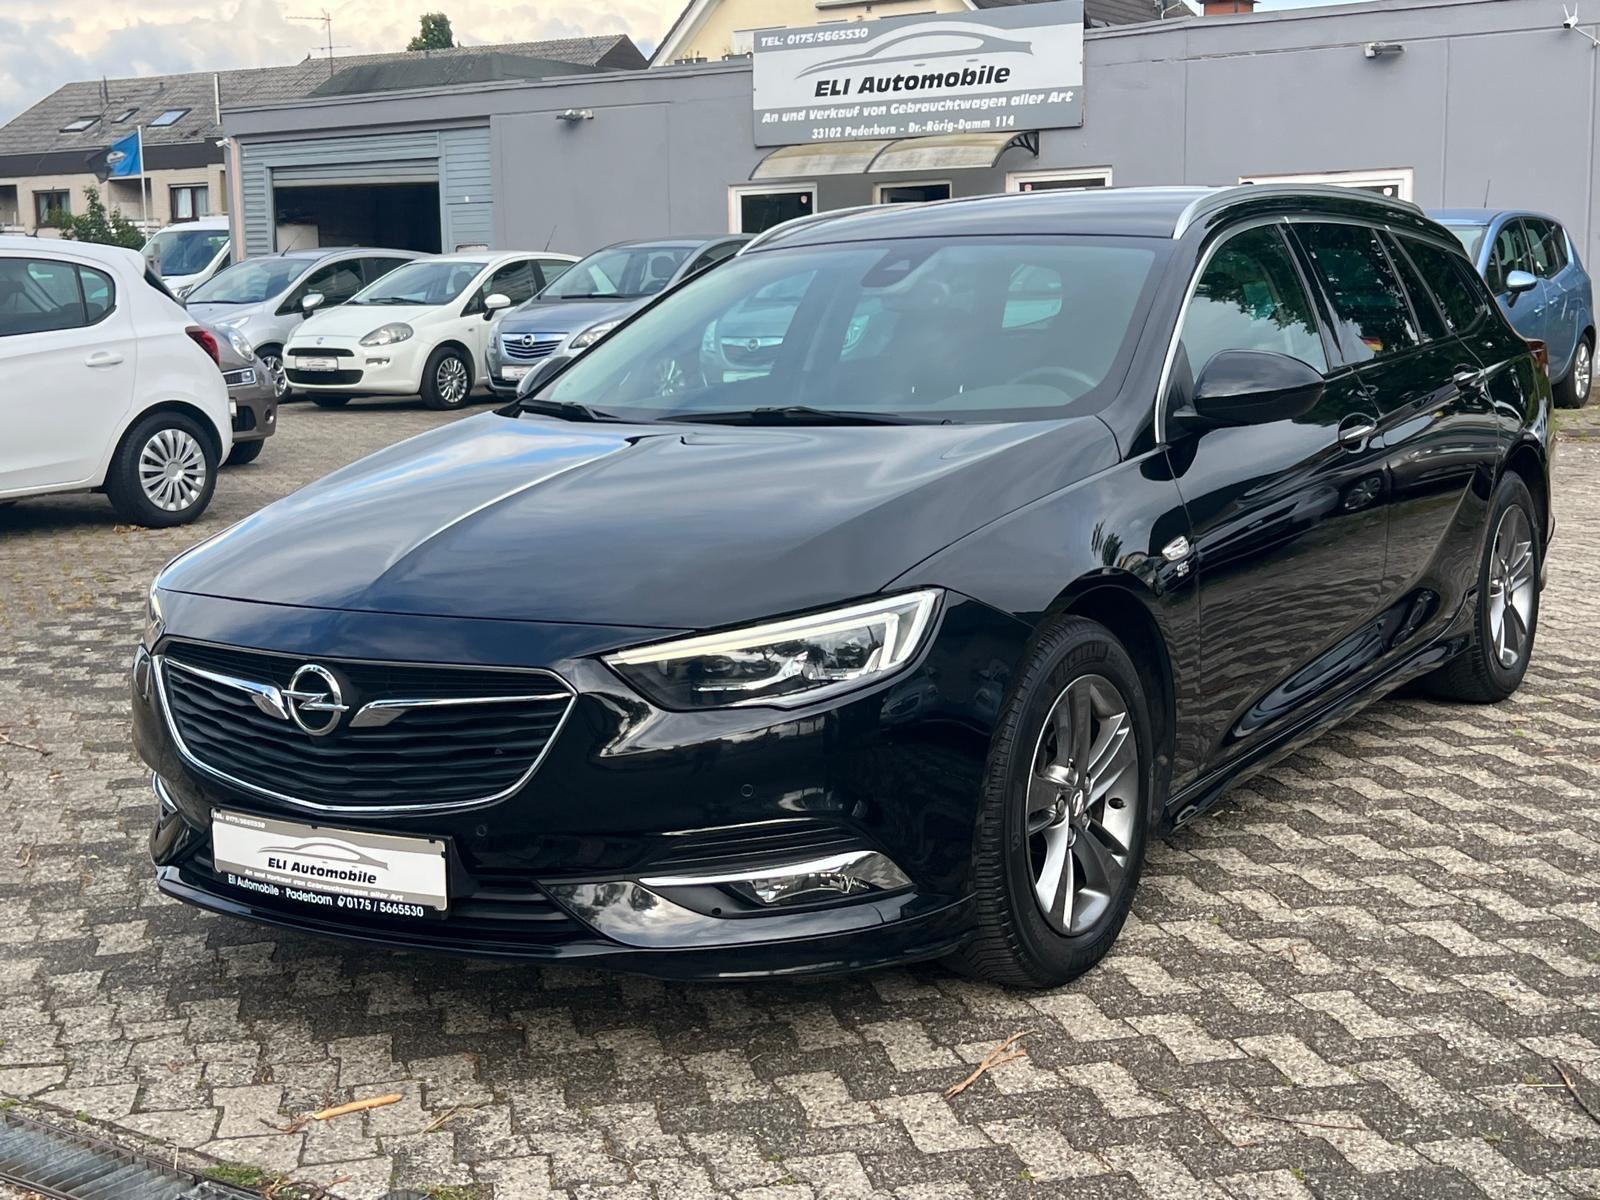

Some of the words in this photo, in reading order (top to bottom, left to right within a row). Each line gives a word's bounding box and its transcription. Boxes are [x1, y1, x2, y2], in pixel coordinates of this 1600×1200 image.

[761, 36, 784, 47] TEL:
[787, 27, 869, 45] 0175/5665530
[814, 78, 851, 98] ELI
[857, 65, 1010, 95] Automobile
[762, 112, 779, 124] An
[782, 110, 806, 122] und
[809, 106, 861, 121] Verkauf
[863, 104, 886, 117] von
[890, 96, 1007, 115] Gebrauchtwagen
[1010, 92, 1044, 106] aller
[1047, 90, 1074, 103] Art
[812, 127, 842, 139] 33102
[845, 124, 896, 138] Paderborn
[908, 118, 991, 134] Dr.-Rörig-Damm
[995, 115, 1015, 127] 114
[268, 857, 287, 870] ELI
[291, 862, 377, 884] Automobile
[228, 874, 236, 885] Eli
[237, 876, 280, 896] Automobile
[286, 888, 333, 906] Paderborn
[347, 896, 372, 911] 0175
[380, 901, 424, 917] 5665530
